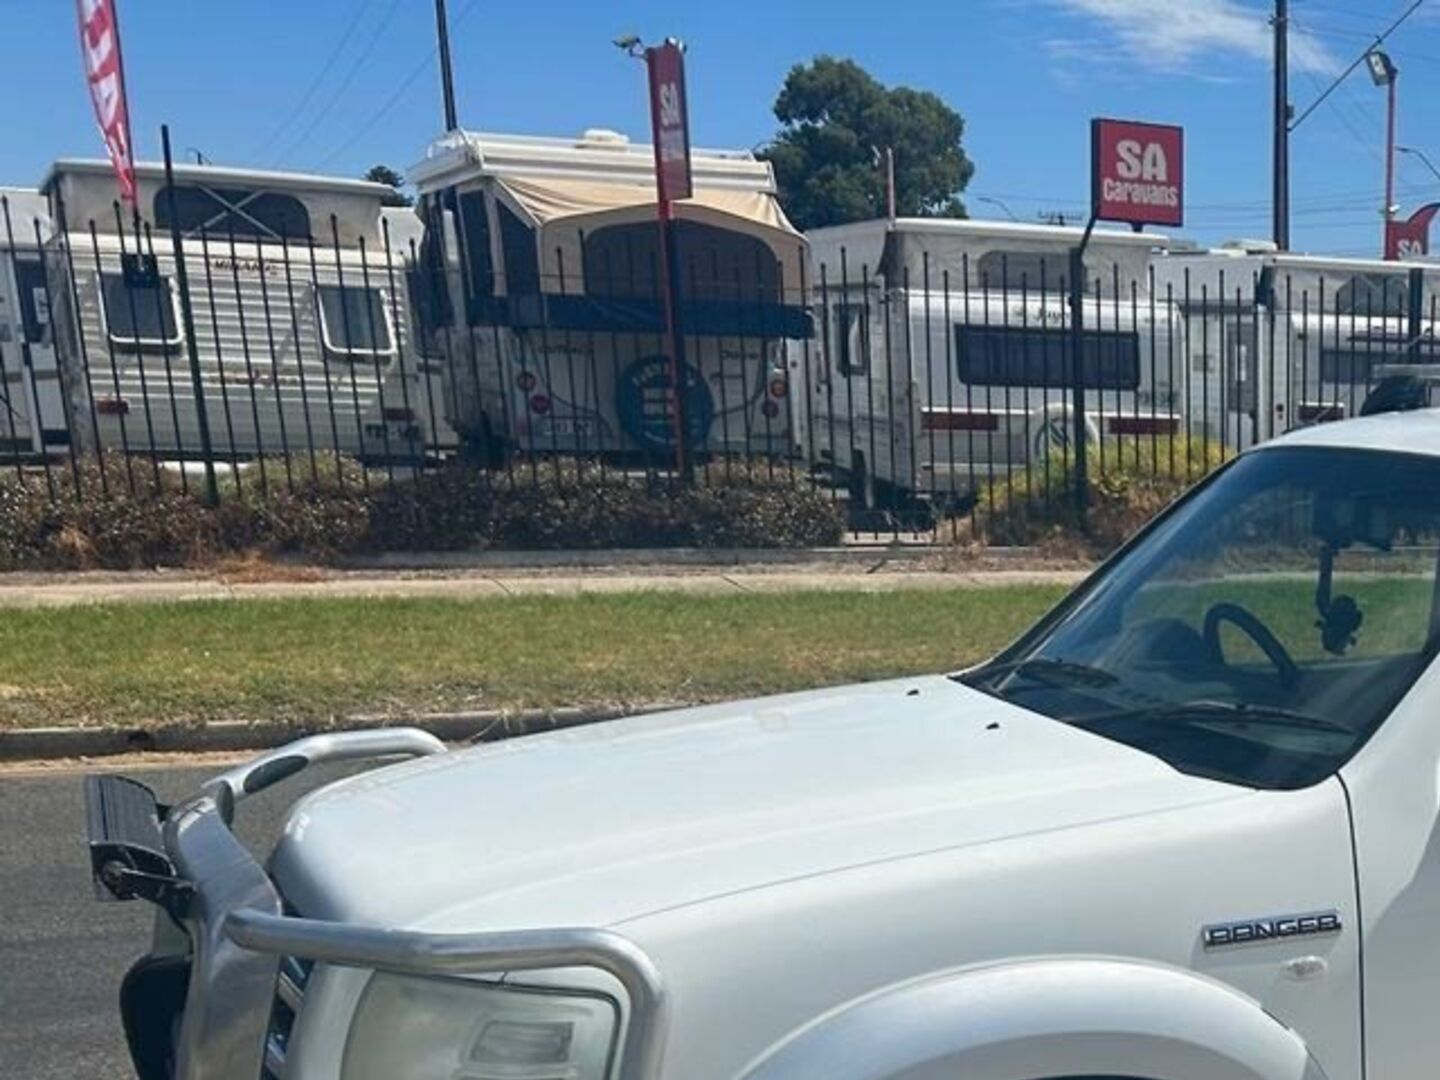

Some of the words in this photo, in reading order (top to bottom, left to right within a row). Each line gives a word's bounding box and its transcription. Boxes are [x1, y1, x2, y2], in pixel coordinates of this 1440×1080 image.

[1116, 140, 1167, 181] SA
[1103, 178, 1178, 207] Caravans
[1204, 914, 1341, 946] RANGER
